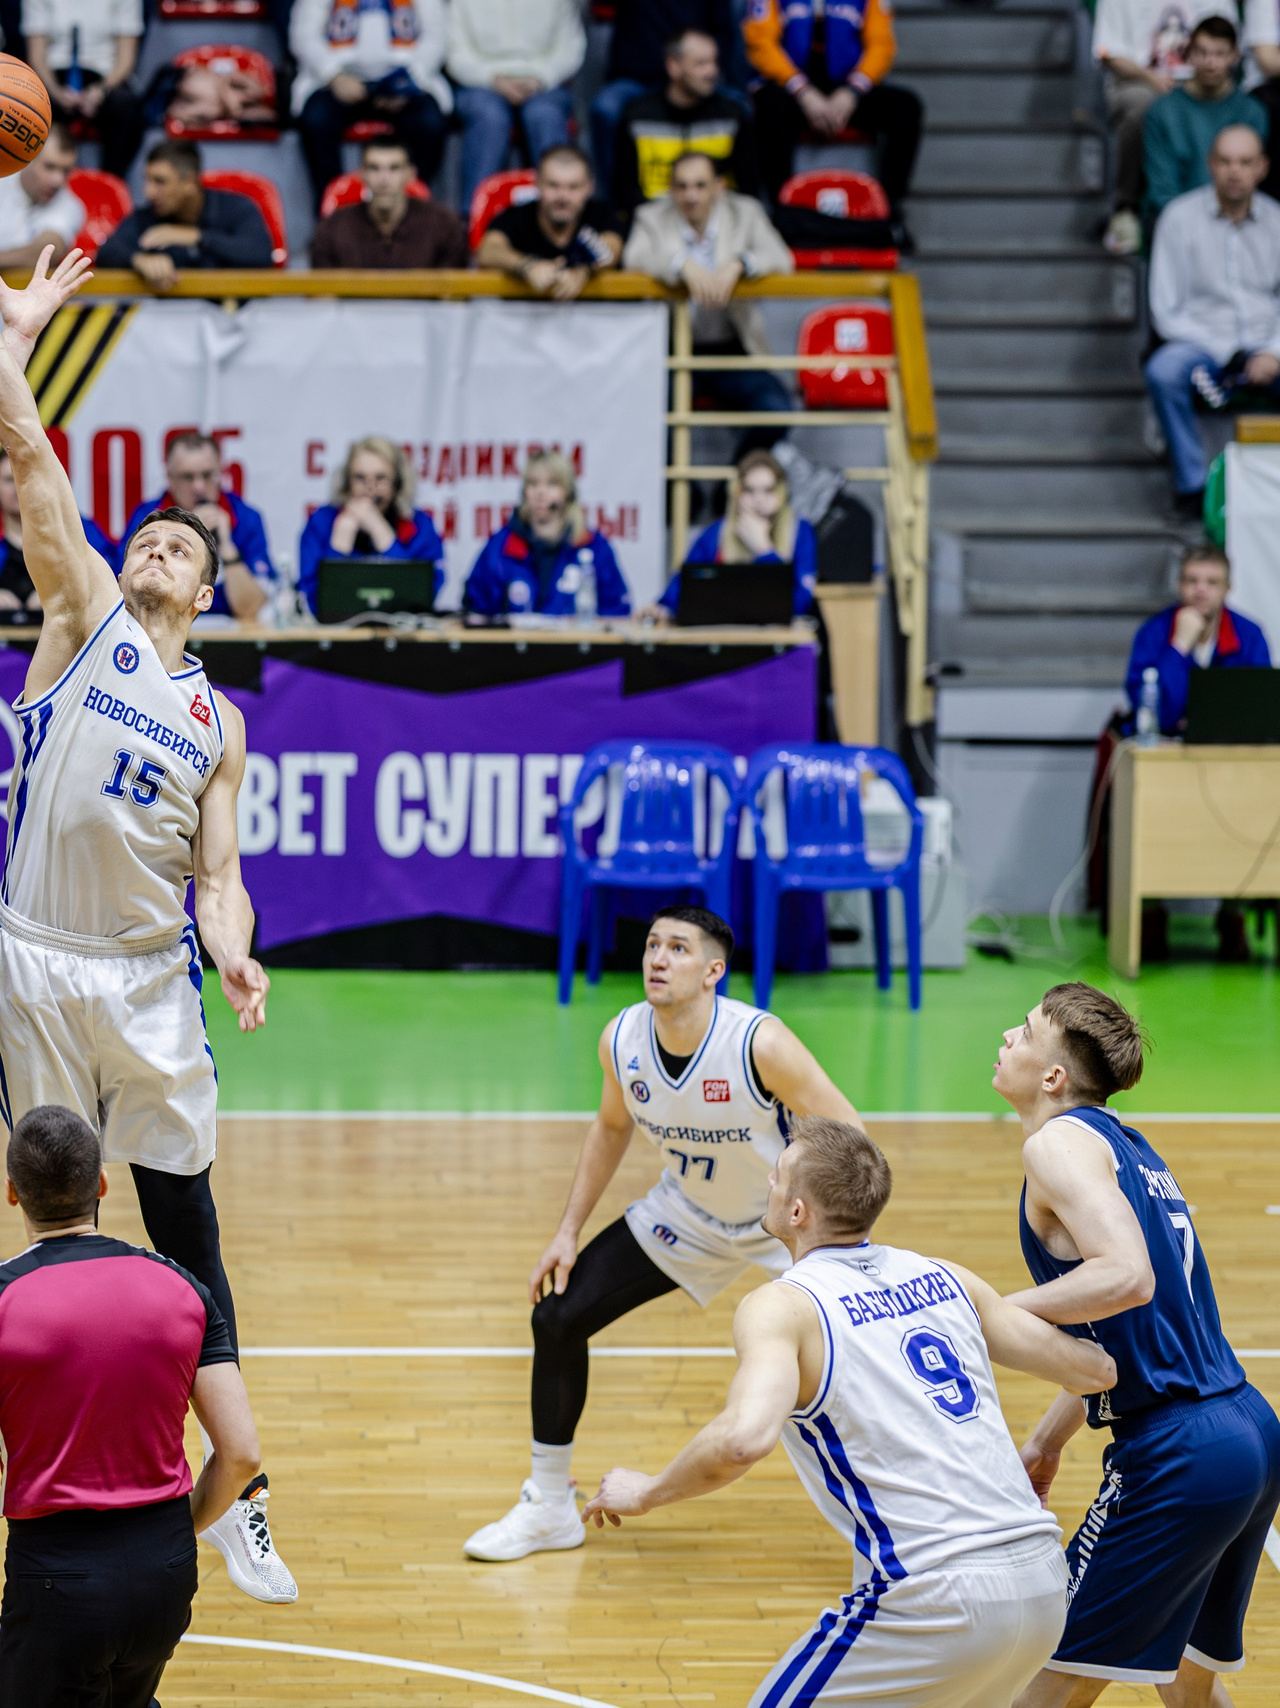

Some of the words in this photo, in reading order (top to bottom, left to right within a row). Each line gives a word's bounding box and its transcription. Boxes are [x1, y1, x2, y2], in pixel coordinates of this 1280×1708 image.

[83, 685, 210, 778] НОВОСИБИРСК
[100, 748, 169, 809] 15
[236, 752, 358, 856] BET
[667, 1149, 718, 1183] 77
[1168, 1212, 1199, 1318] 7
[900, 1326, 980, 1424] 9
